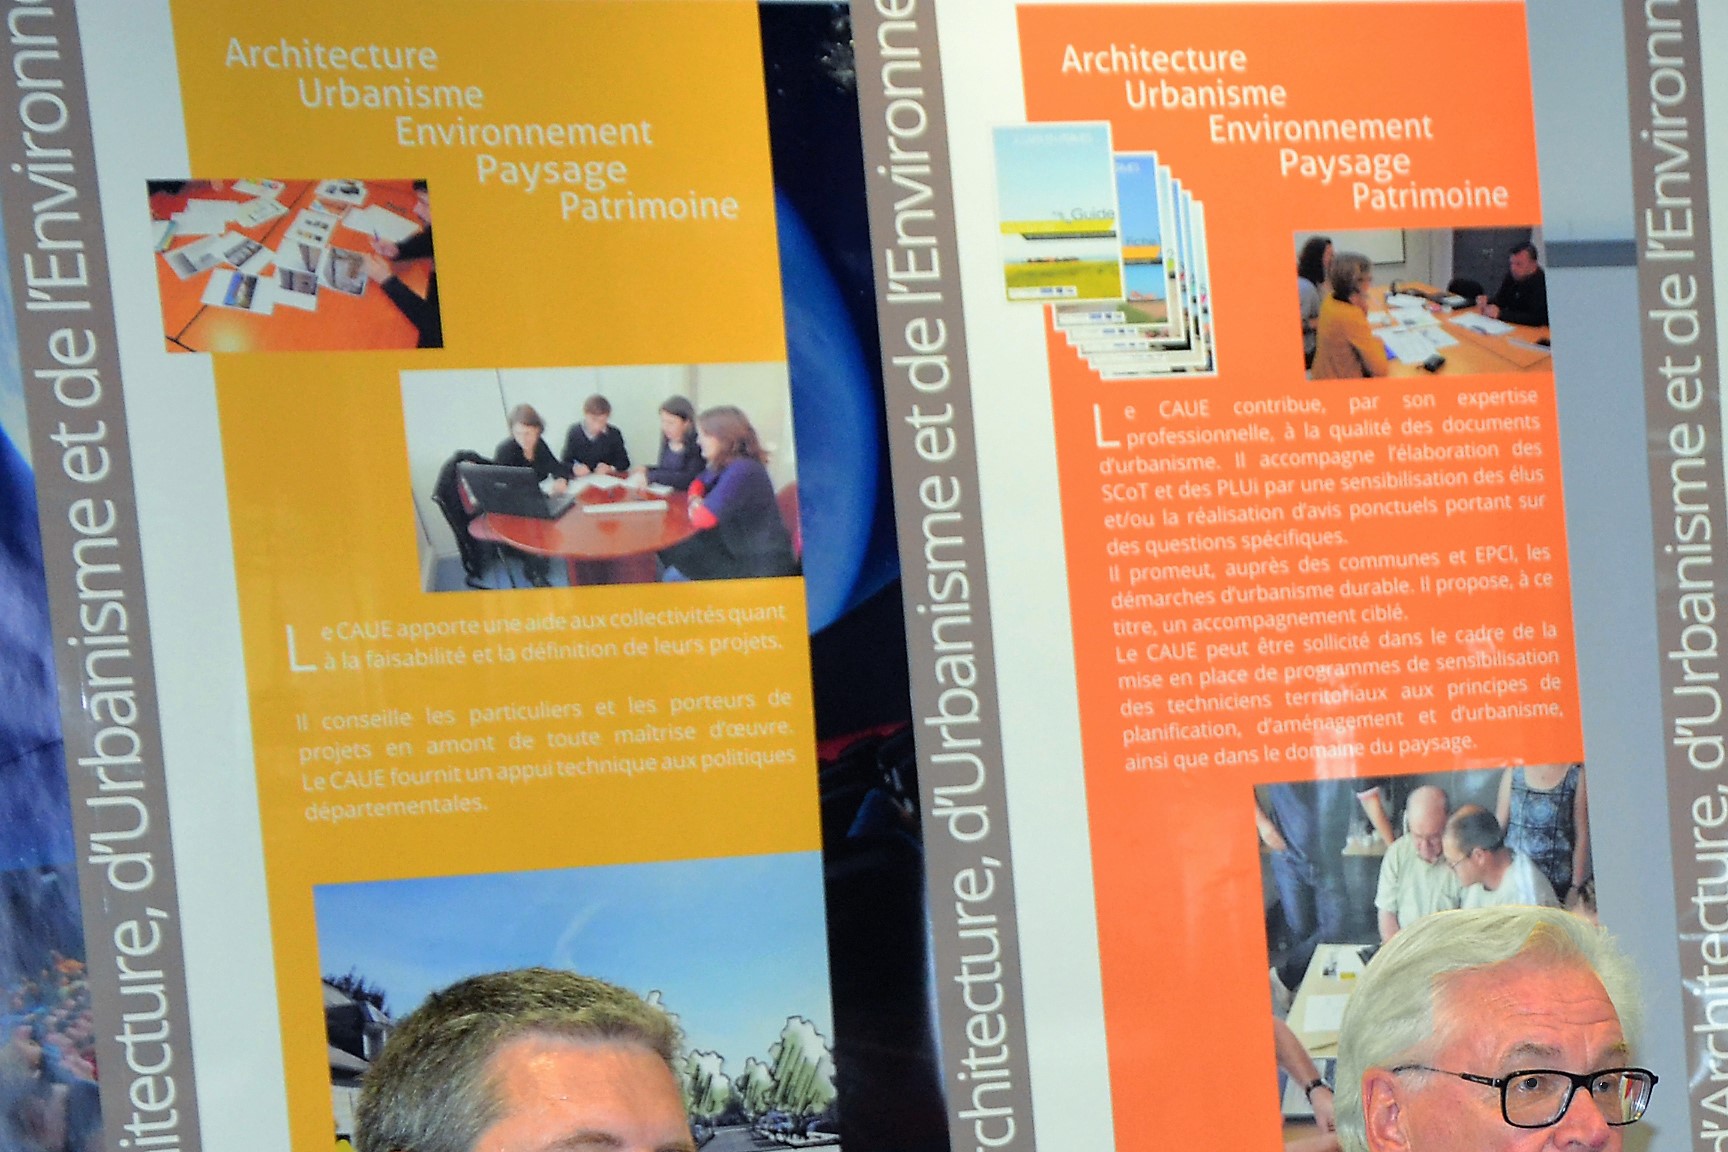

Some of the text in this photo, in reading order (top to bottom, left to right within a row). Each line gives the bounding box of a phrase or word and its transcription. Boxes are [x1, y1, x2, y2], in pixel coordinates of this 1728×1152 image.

[225, 37, 438, 70] Architecture
[1061, 44, 1247, 74] Architecture
[299, 77, 484, 109] Urbanisme
[1125, 80, 1287, 109] Urbanisme
[396, 116, 653, 147] Environnement
[1210, 113, 1433, 144] Environnement
[8, 0, 91, 310] l'Environn
[477, 154, 627, 191] Paysage
[1279, 147, 1410, 183] Paysage
[560, 192, 738, 222] Patrimoine
[1352, 182, 1508, 210] Patrimoine
[1649, 274, 1698, 344] de
[35, 329, 101, 407] de
[893, 318, 951, 393] de
[1659, 356, 1701, 410] et
[905, 403, 957, 461] et
[1284, 422, 1295, 440] à
[1304, 422, 1320, 440] la
[1330, 419, 1391, 442] qualité
[1402, 418, 1433, 436] des
[1442, 416, 1540, 433] documents
[51, 421, 109, 482] et
[1109, 565, 1120, 582] Il
[1226, 557, 1289, 579] auprès
[1298, 555, 1330, 573] des
[1339, 553, 1440, 571] communes
[1449, 550, 1466, 565] et
[1527, 544, 1551, 561] les
[1665, 424, 1724, 770] d'Urbanisme
[917, 476, 990, 841] d'Urbanisme
[79, 499, 152, 891] d'Urbanisme
[296, 688, 792, 731] Il conseille les particuliers et les porteurs de
